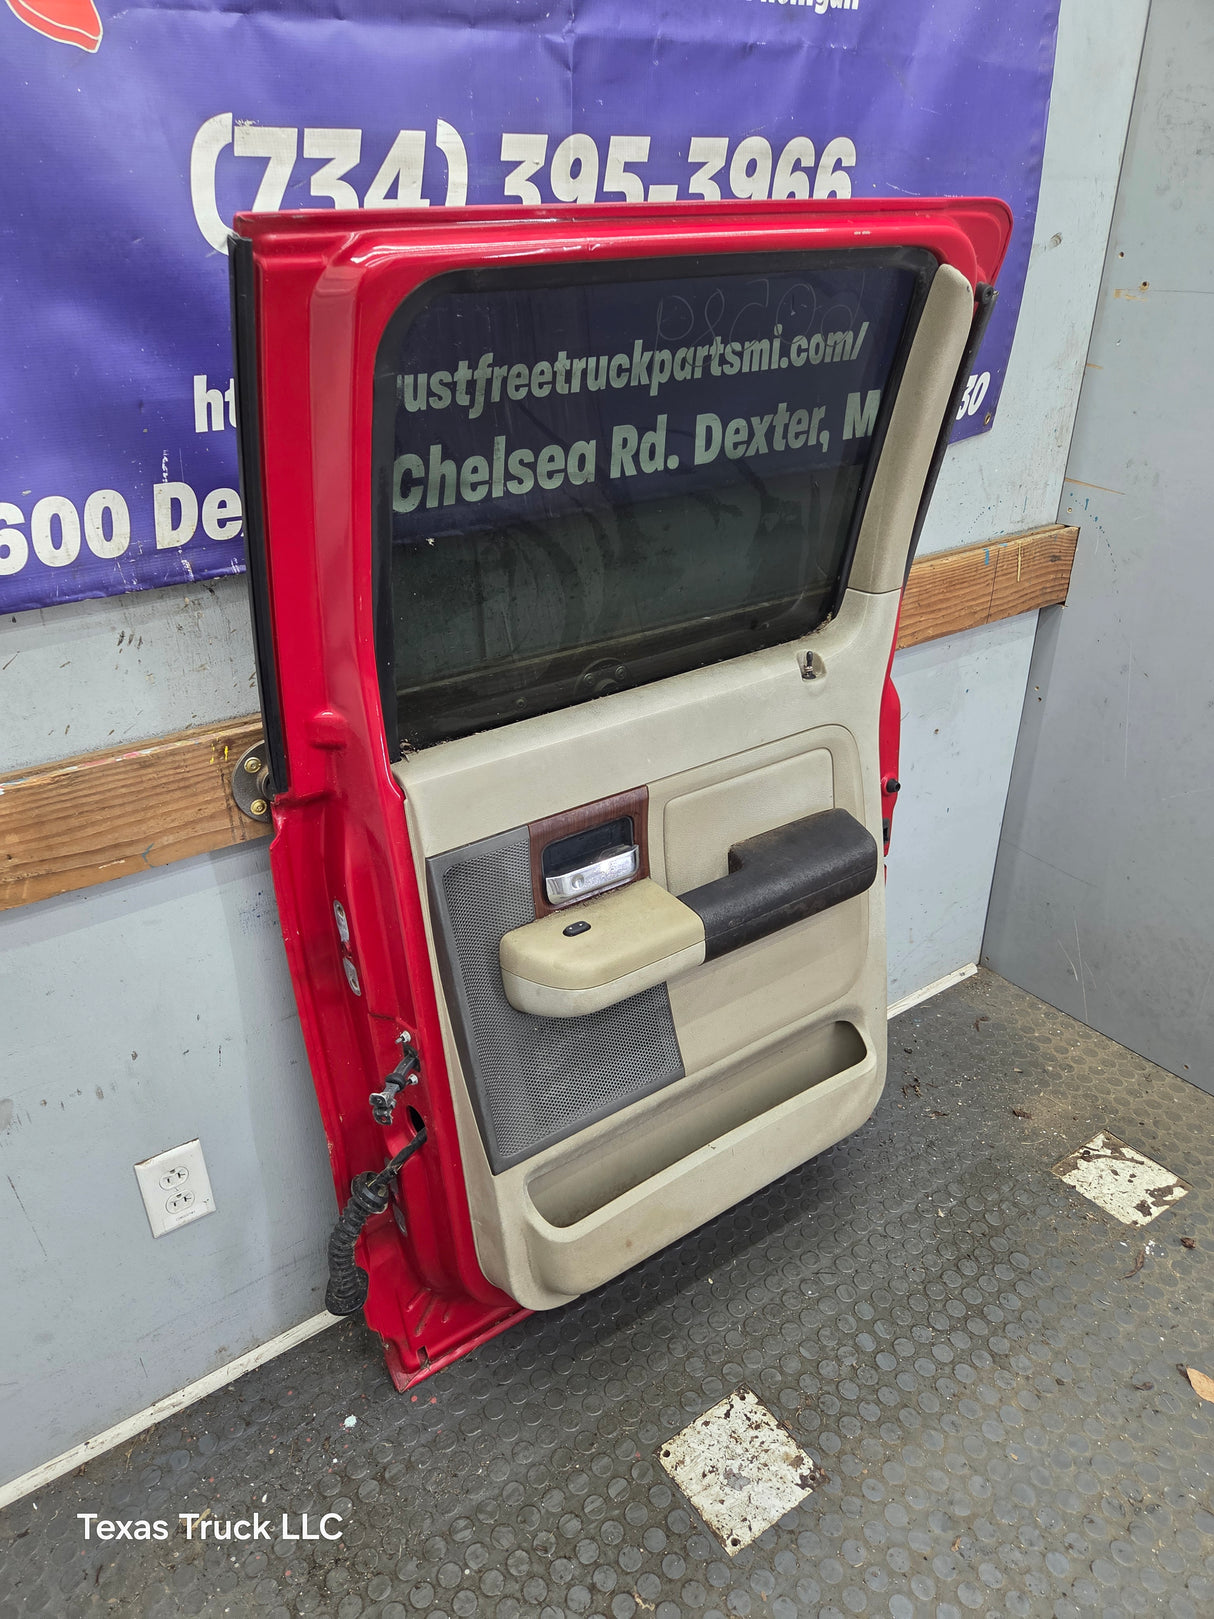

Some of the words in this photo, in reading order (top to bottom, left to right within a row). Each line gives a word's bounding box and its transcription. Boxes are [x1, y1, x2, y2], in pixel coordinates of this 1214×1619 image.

[190, 113, 469, 256] (734)
[500, 133, 857, 205] 395-3966
[153, 481, 244, 550] De
[392, 436, 597, 513] Chelsea
[609, 413, 680, 480] Rd.
[694, 403, 830, 465] Dexter,
